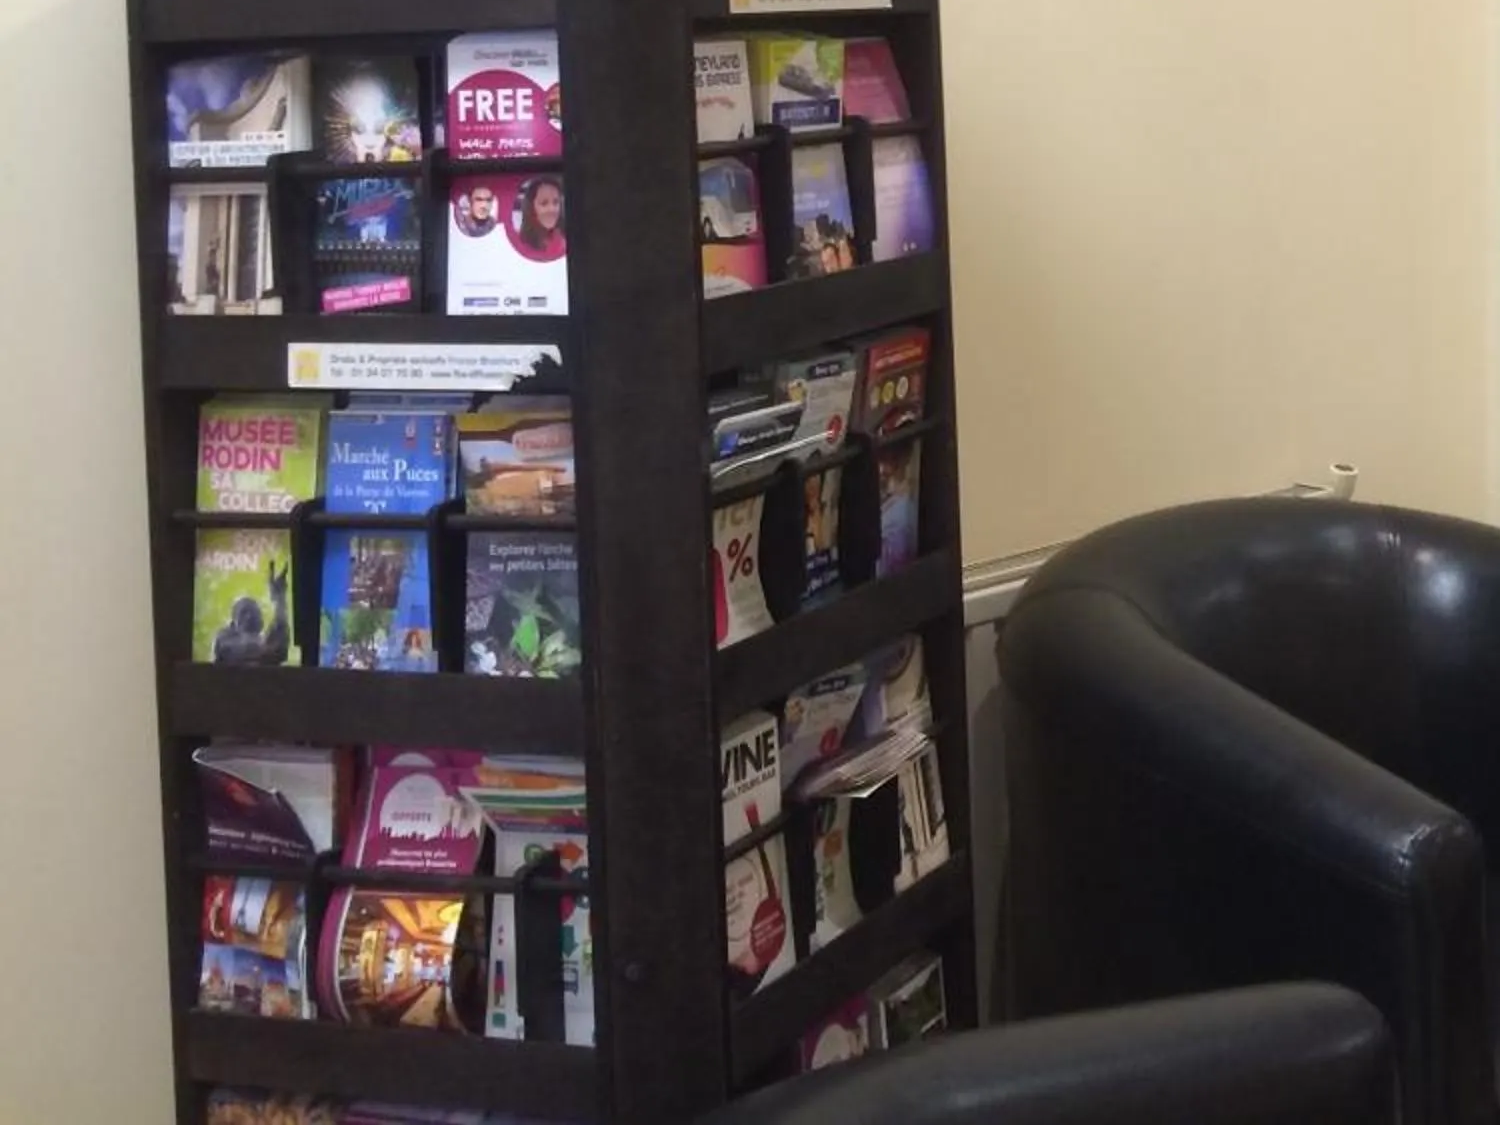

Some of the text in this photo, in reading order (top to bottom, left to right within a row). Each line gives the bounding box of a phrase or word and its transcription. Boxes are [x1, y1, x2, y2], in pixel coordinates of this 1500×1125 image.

[457, 87, 534, 123] FREE
[202, 445, 281, 472] RODIN
[331, 442, 390, 465] Marché
[363, 459, 439, 482] aux Puces
[726, 533, 754, 583] %
